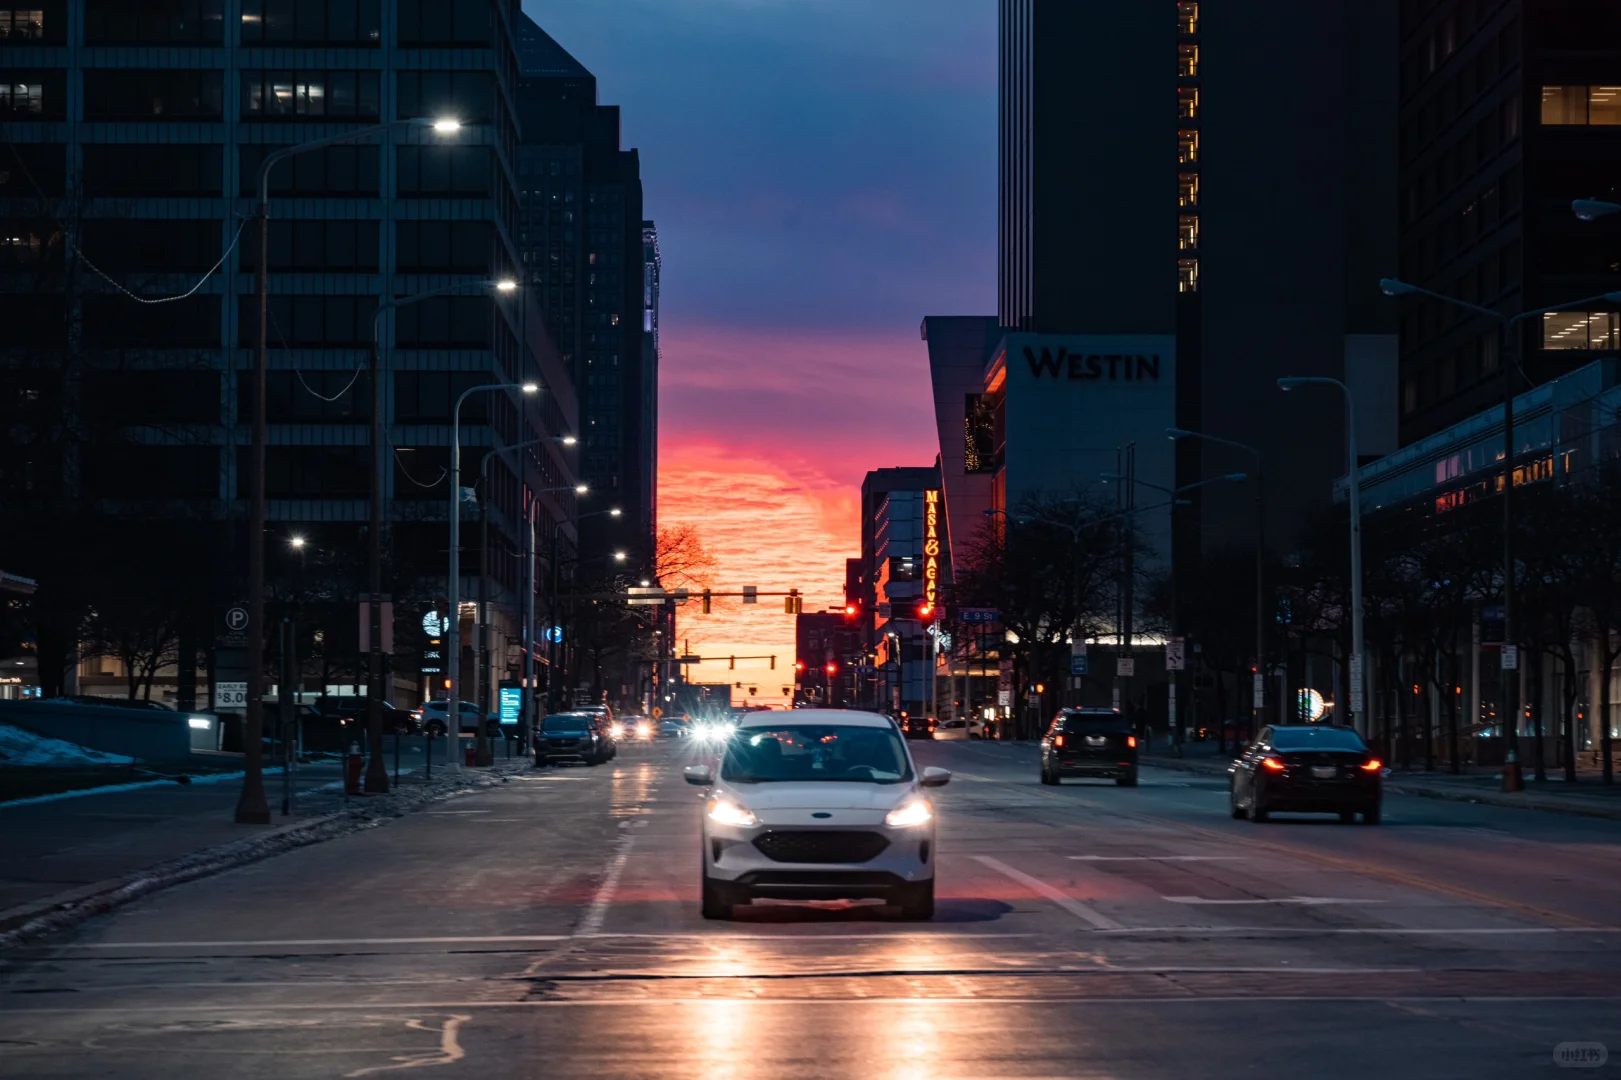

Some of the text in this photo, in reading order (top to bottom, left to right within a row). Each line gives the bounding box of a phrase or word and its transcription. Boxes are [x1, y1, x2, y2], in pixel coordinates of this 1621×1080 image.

[926, 490, 939, 538] MASA
[925, 539, 939, 556] &
[964, 612, 971, 620] E
[974, 612, 981, 620] 9
